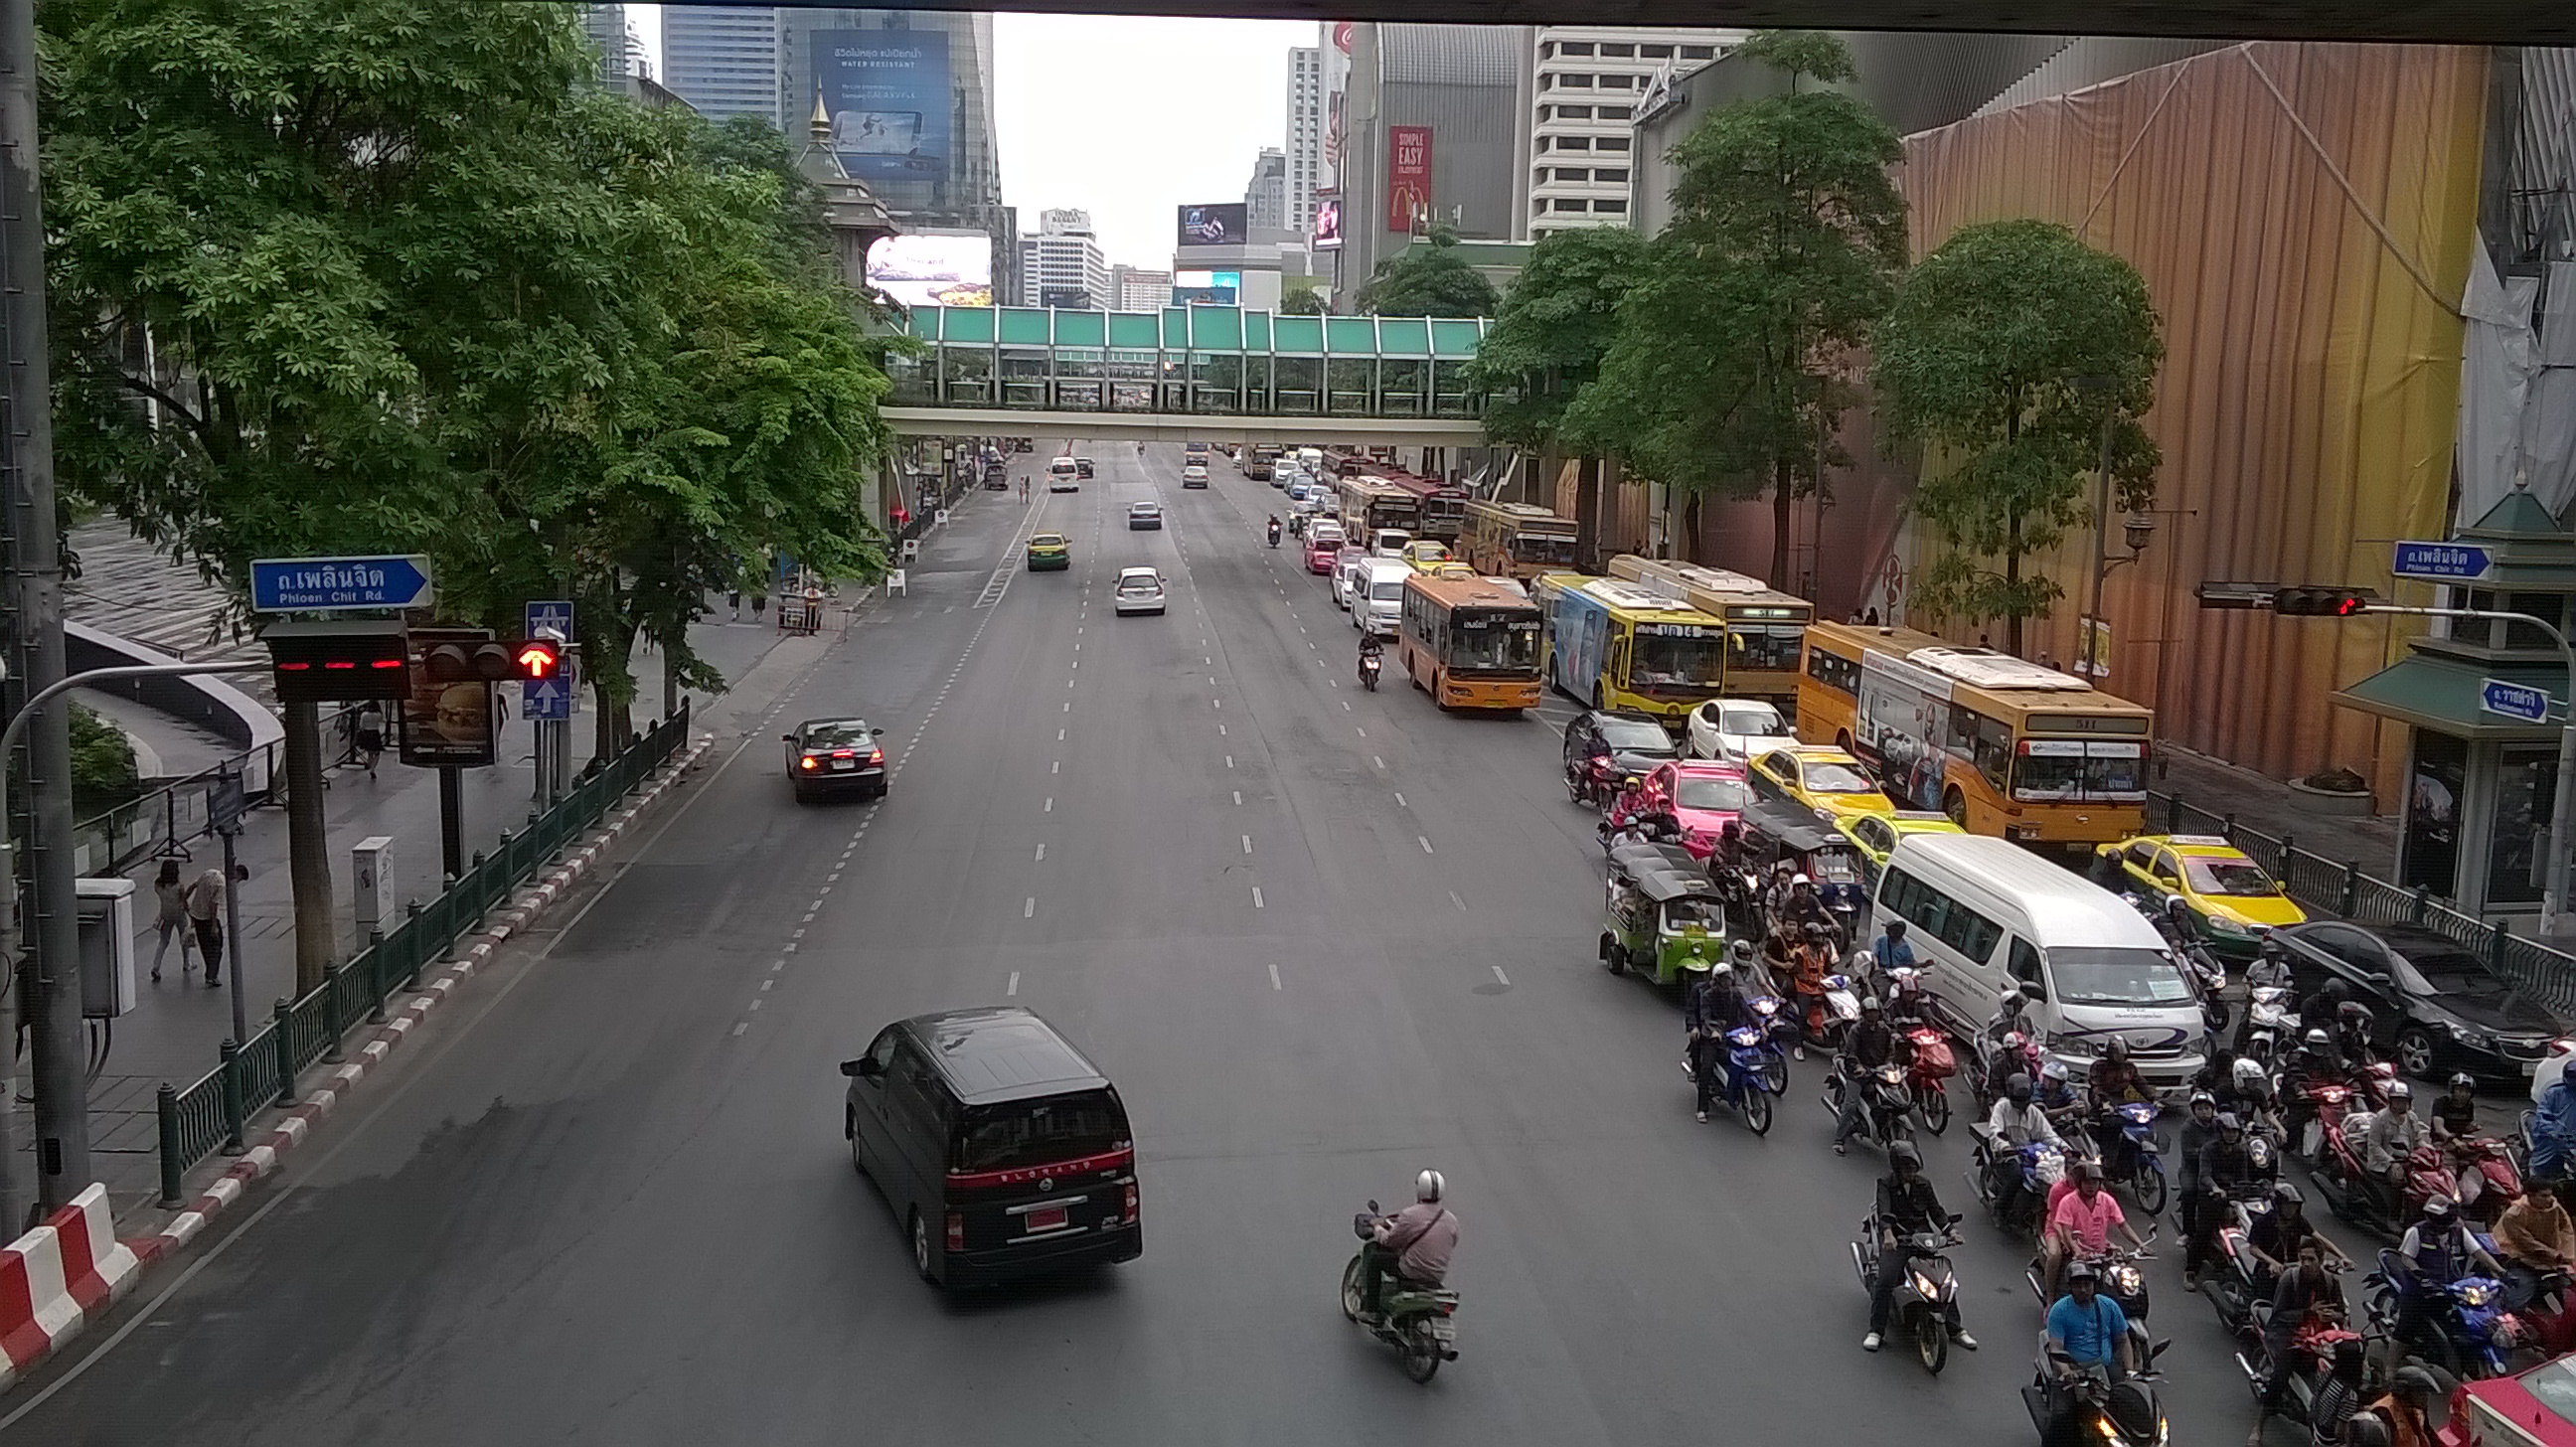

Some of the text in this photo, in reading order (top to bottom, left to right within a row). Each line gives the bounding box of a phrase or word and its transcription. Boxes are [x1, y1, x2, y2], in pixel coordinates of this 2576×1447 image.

[1399, 133, 1423, 146] SIMPLE
[1398, 147, 1423, 165] EASY
[278, 563, 385, 589] ถ.เพลินจิต
[279, 589, 385, 603] Phloen Chit Rd.
